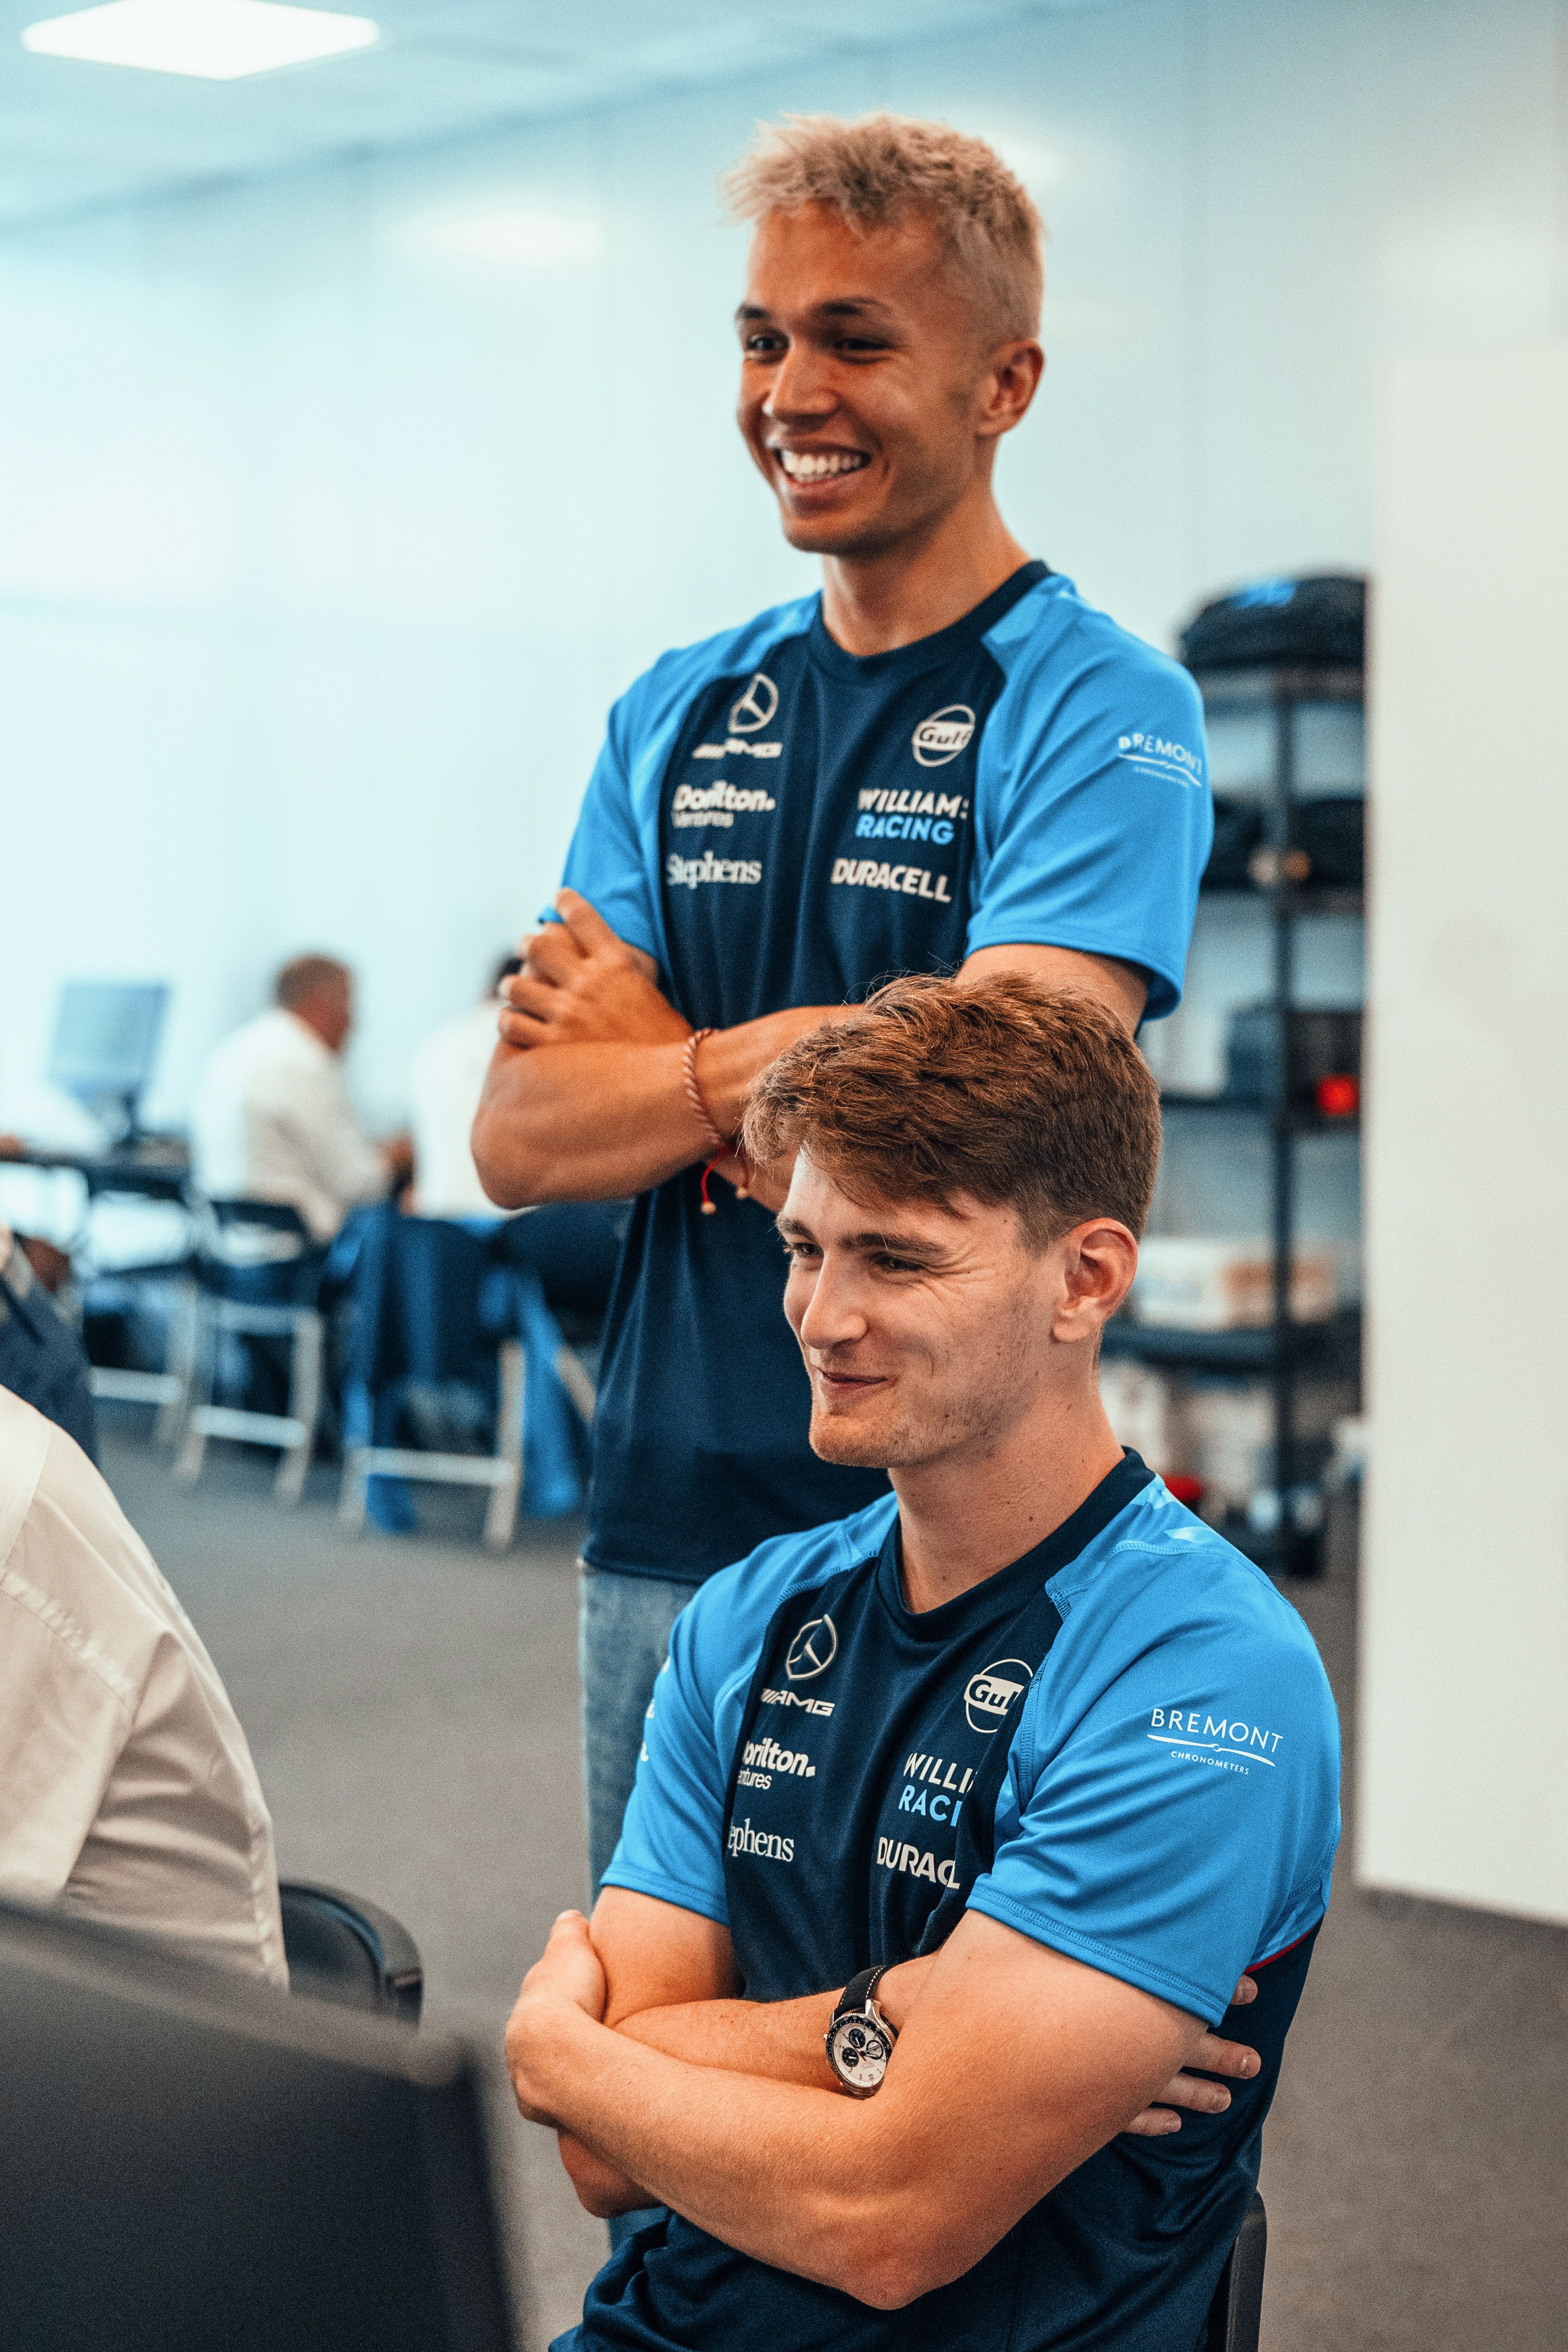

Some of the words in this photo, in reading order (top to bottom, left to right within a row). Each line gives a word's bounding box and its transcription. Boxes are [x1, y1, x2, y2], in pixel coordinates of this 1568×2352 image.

[855, 813, 955, 845] RACING
[831, 858, 951, 903] DURACELL
[969, 1679, 1019, 1711] Gul
[1151, 1708, 1284, 1753] BREMONT
[903, 1752, 978, 1794] WILLI
[1171, 1751, 1249, 1775] CHRONOMETERS
[898, 1784, 963, 1827] RACI
[727, 1817, 794, 1862] ephens
